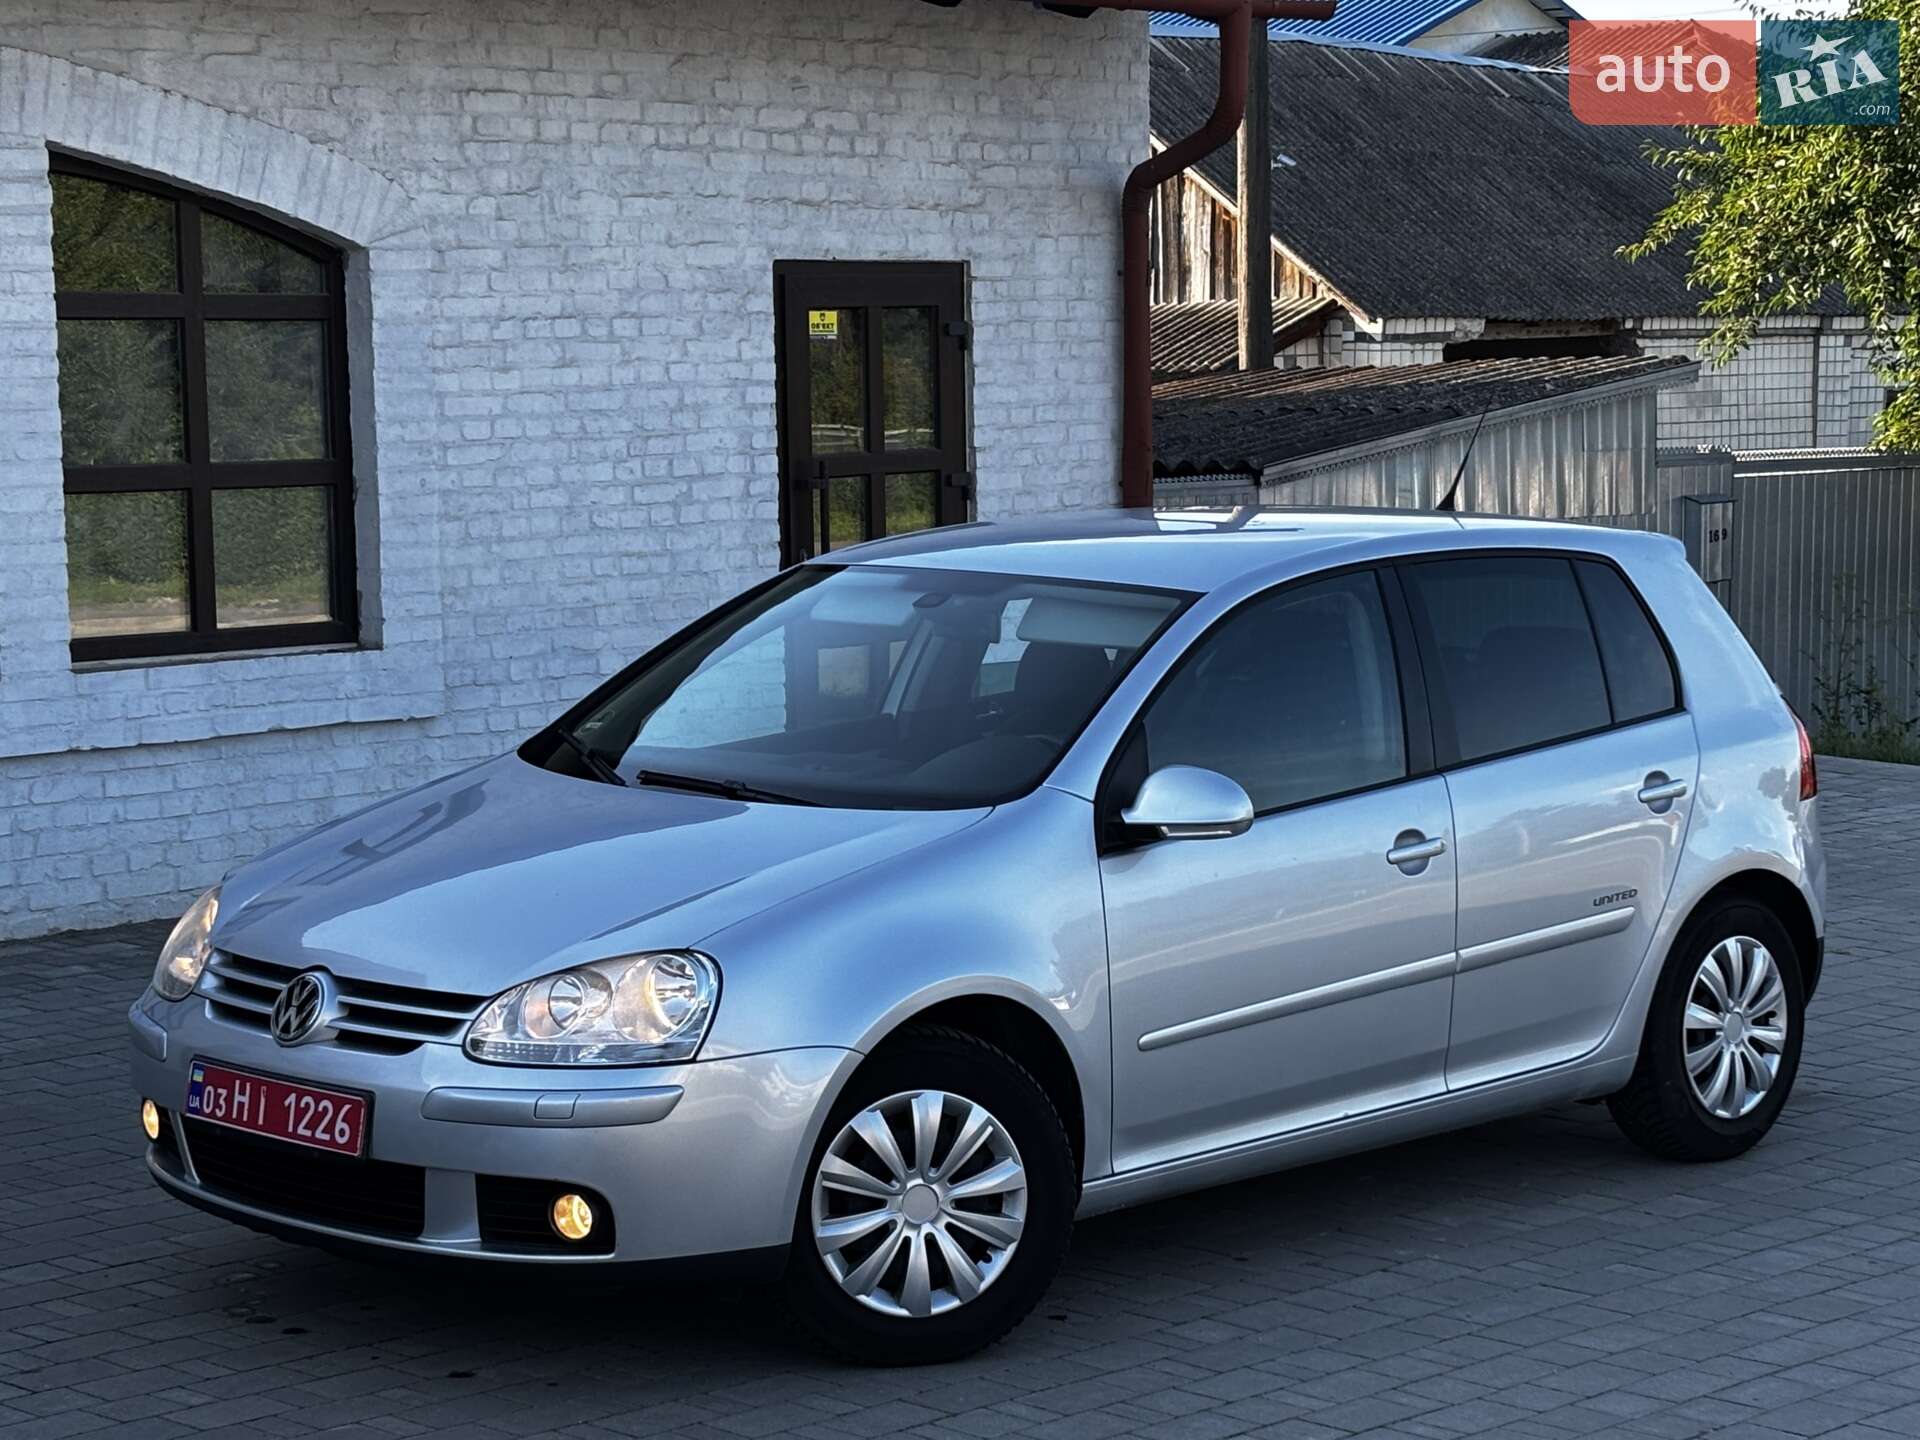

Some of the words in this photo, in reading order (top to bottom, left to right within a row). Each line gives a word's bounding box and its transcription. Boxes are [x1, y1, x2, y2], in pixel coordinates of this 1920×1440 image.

[1708, 528, 1727, 543] 169
[1593, 889, 1638, 907] UNITED
[188, 1096, 201, 1108] UA
[283, 1092, 353, 1145] 1226
